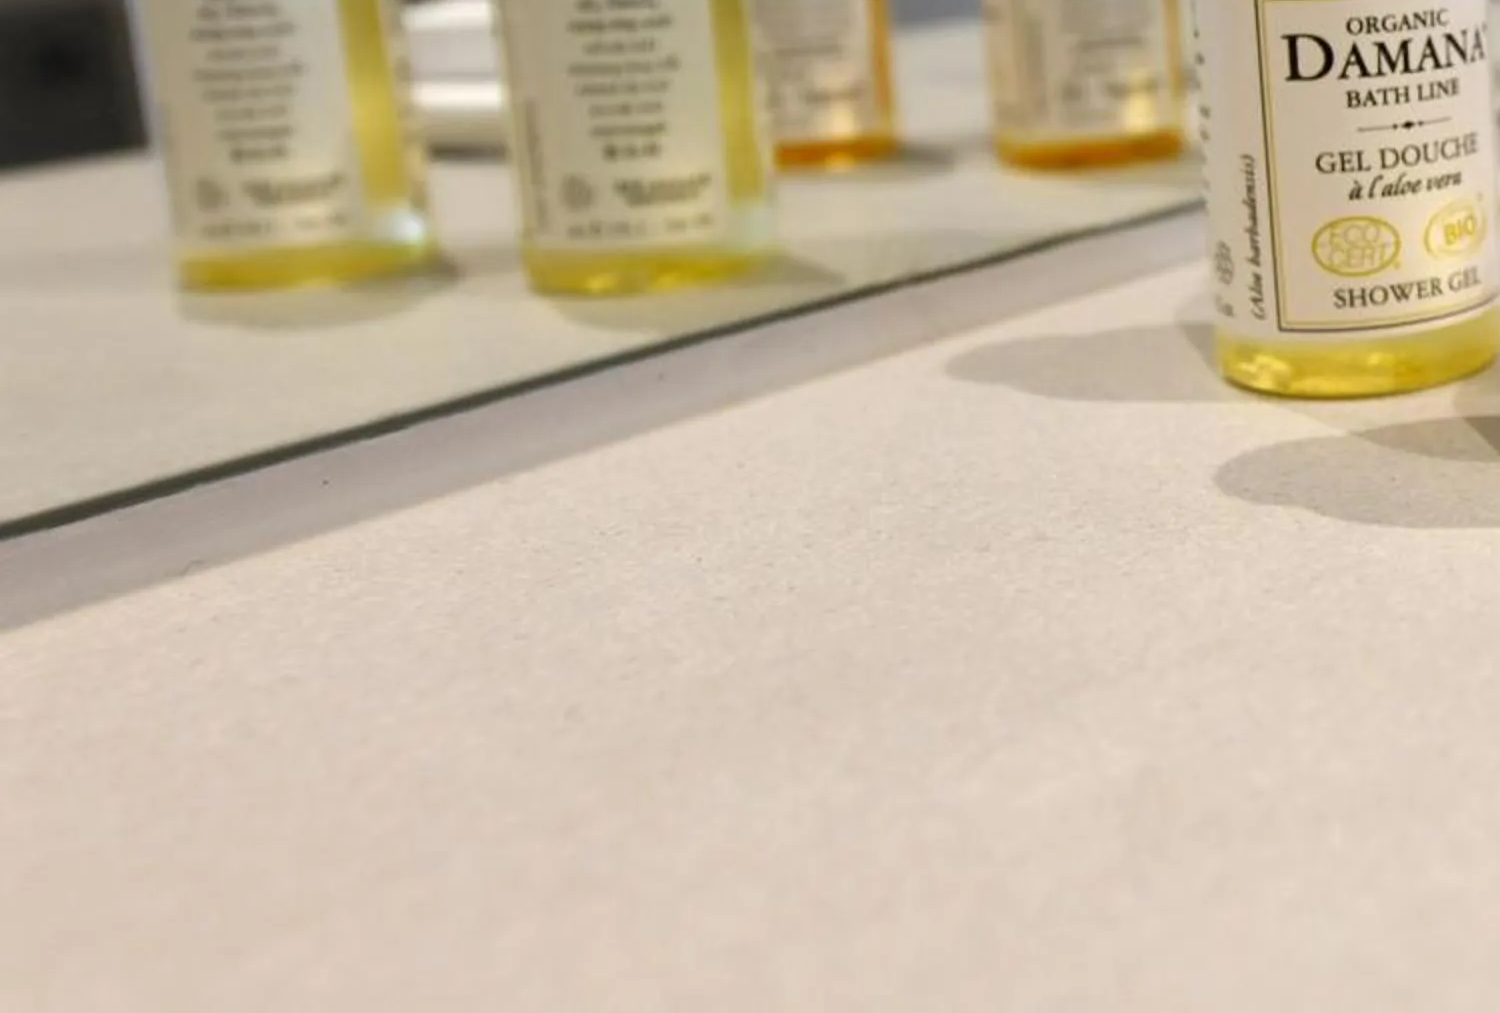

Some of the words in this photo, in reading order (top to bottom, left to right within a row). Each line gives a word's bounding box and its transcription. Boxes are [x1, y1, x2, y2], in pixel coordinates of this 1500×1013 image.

[1346, 9, 1449, 35] ORGANIC
[1280, 24, 1487, 82] DAMANA
[1347, 85, 1410, 109] BATH
[1417, 78, 1460, 102] LINE
[1314, 149, 1372, 175] GEL
[1378, 131, 1479, 170] DOUCHE
[1426, 171, 1463, 192] vera
[1444, 214, 1477, 247] BIO
[1333, 277, 1444, 309] SHOWER
[1447, 266, 1482, 293] GEL
